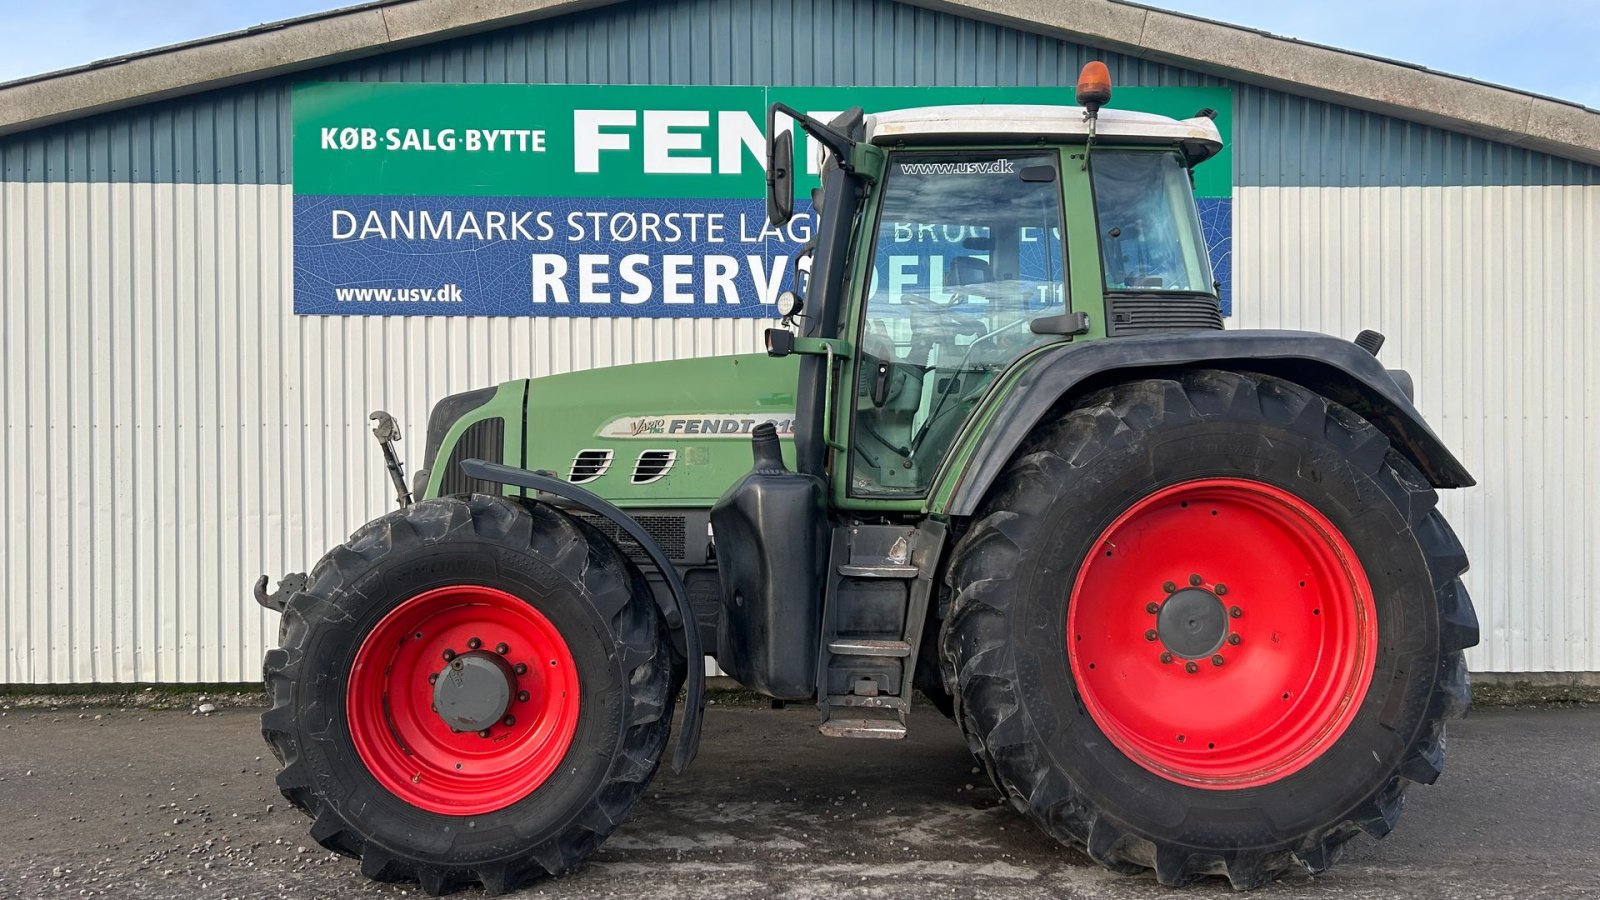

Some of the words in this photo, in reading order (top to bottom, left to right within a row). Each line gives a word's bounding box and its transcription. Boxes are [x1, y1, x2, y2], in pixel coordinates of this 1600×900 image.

[900, 158, 1014, 175] www.usv.dk
[332, 209, 554, 241] DANMARKS
[567, 211, 725, 243] STØRSTE
[740, 212, 820, 243] LAG
[335, 283, 463, 302] www.usv.dk
[668, 418, 755, 434] FENDT
